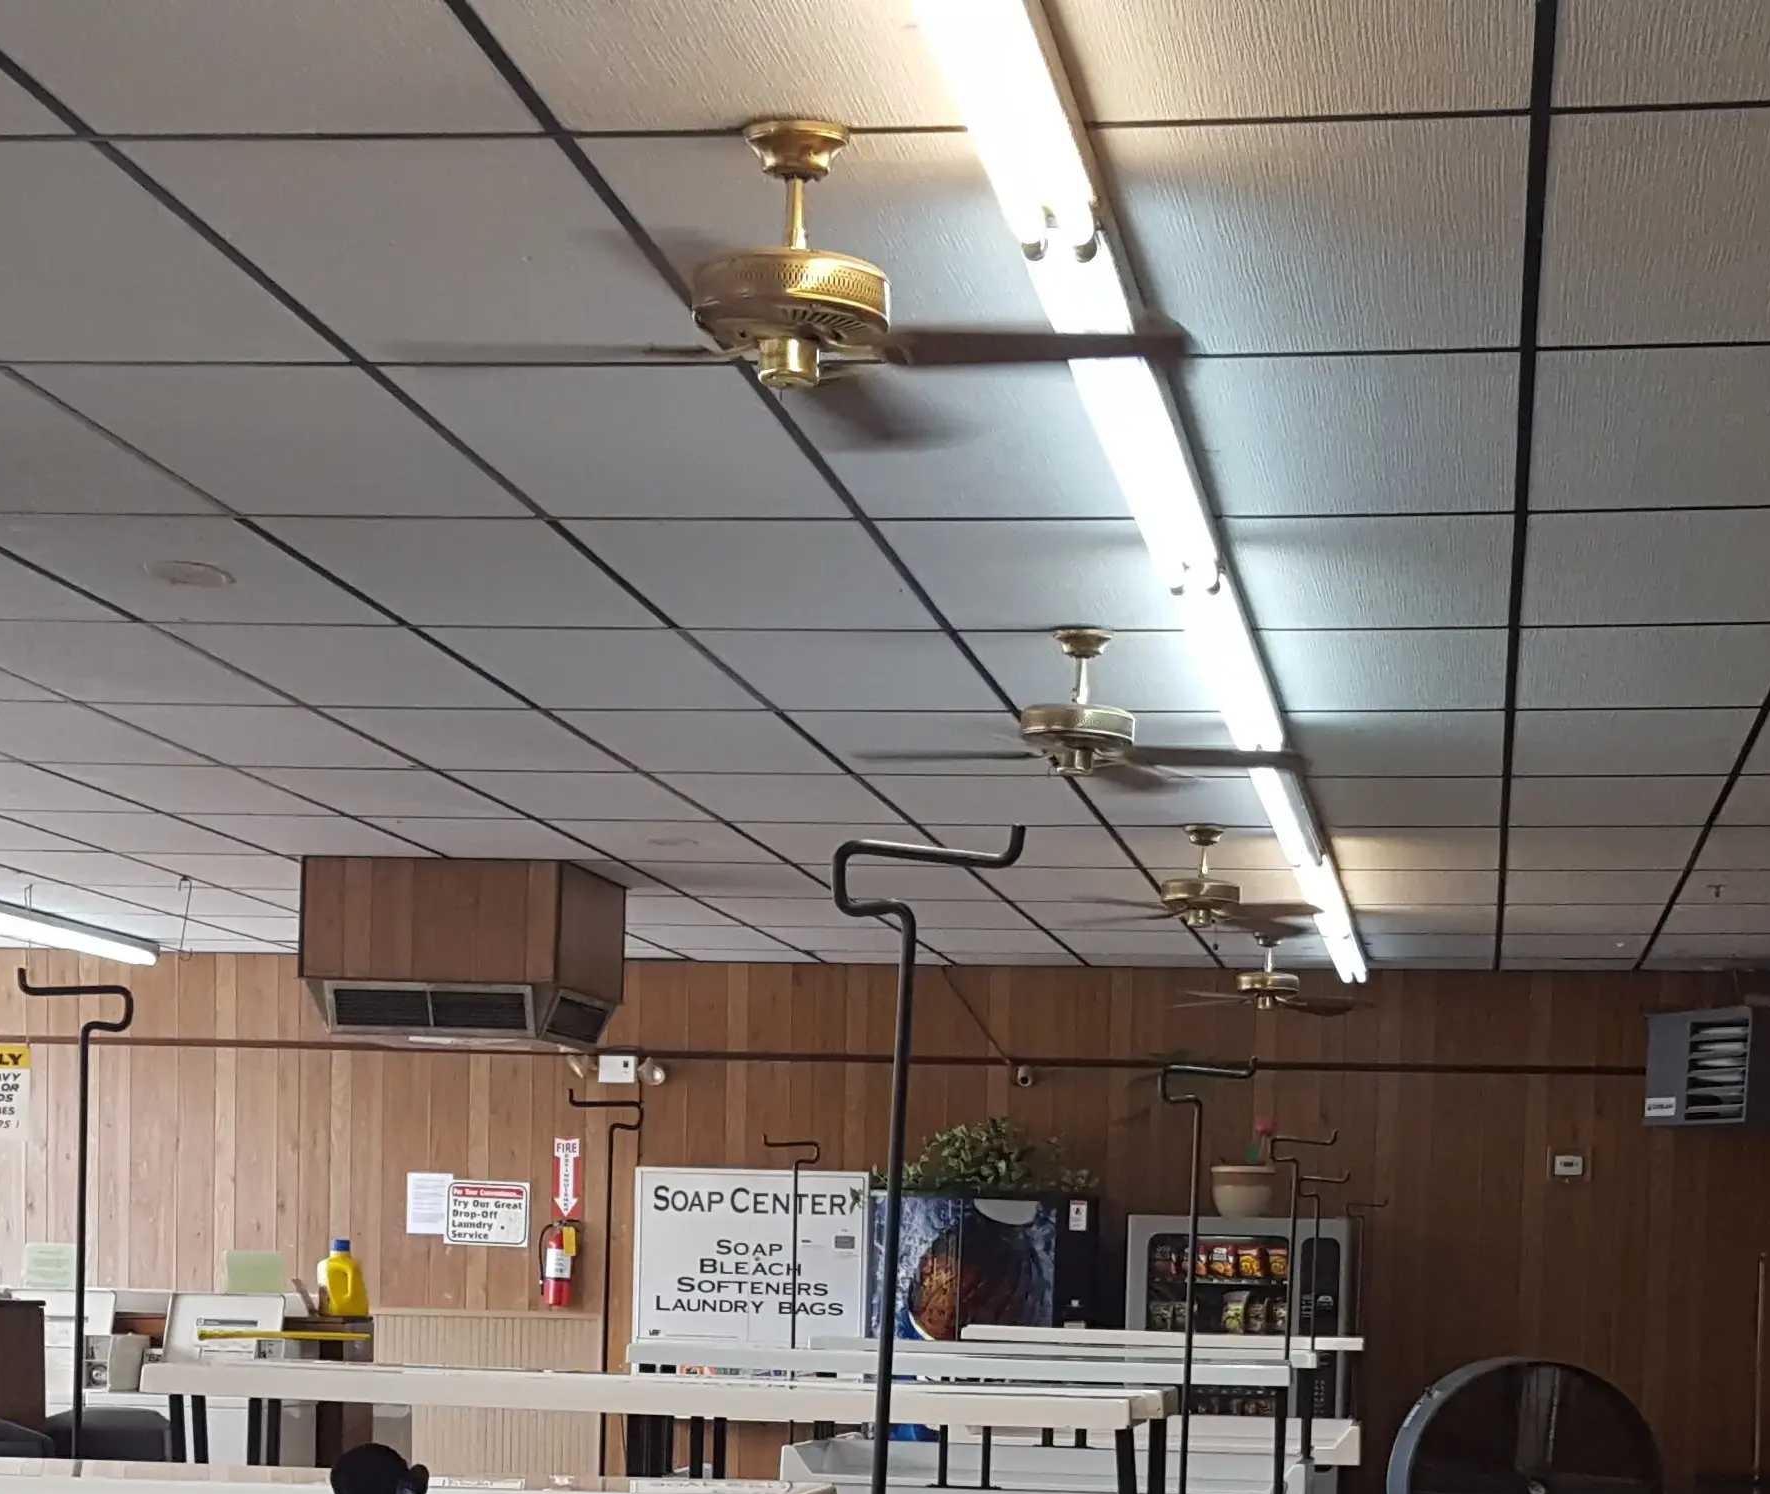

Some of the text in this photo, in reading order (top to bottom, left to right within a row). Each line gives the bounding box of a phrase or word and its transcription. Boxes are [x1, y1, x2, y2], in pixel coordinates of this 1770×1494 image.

[1, 1083, 20, 1092] OR
[556, 1142, 577, 1153] FIRE
[453, 1199, 523, 1209] Try Our Great
[452, 1209, 497, 1219] Drop-Off
[452, 1220, 493, 1231] Laundry
[451, 1230, 489, 1240] Service
